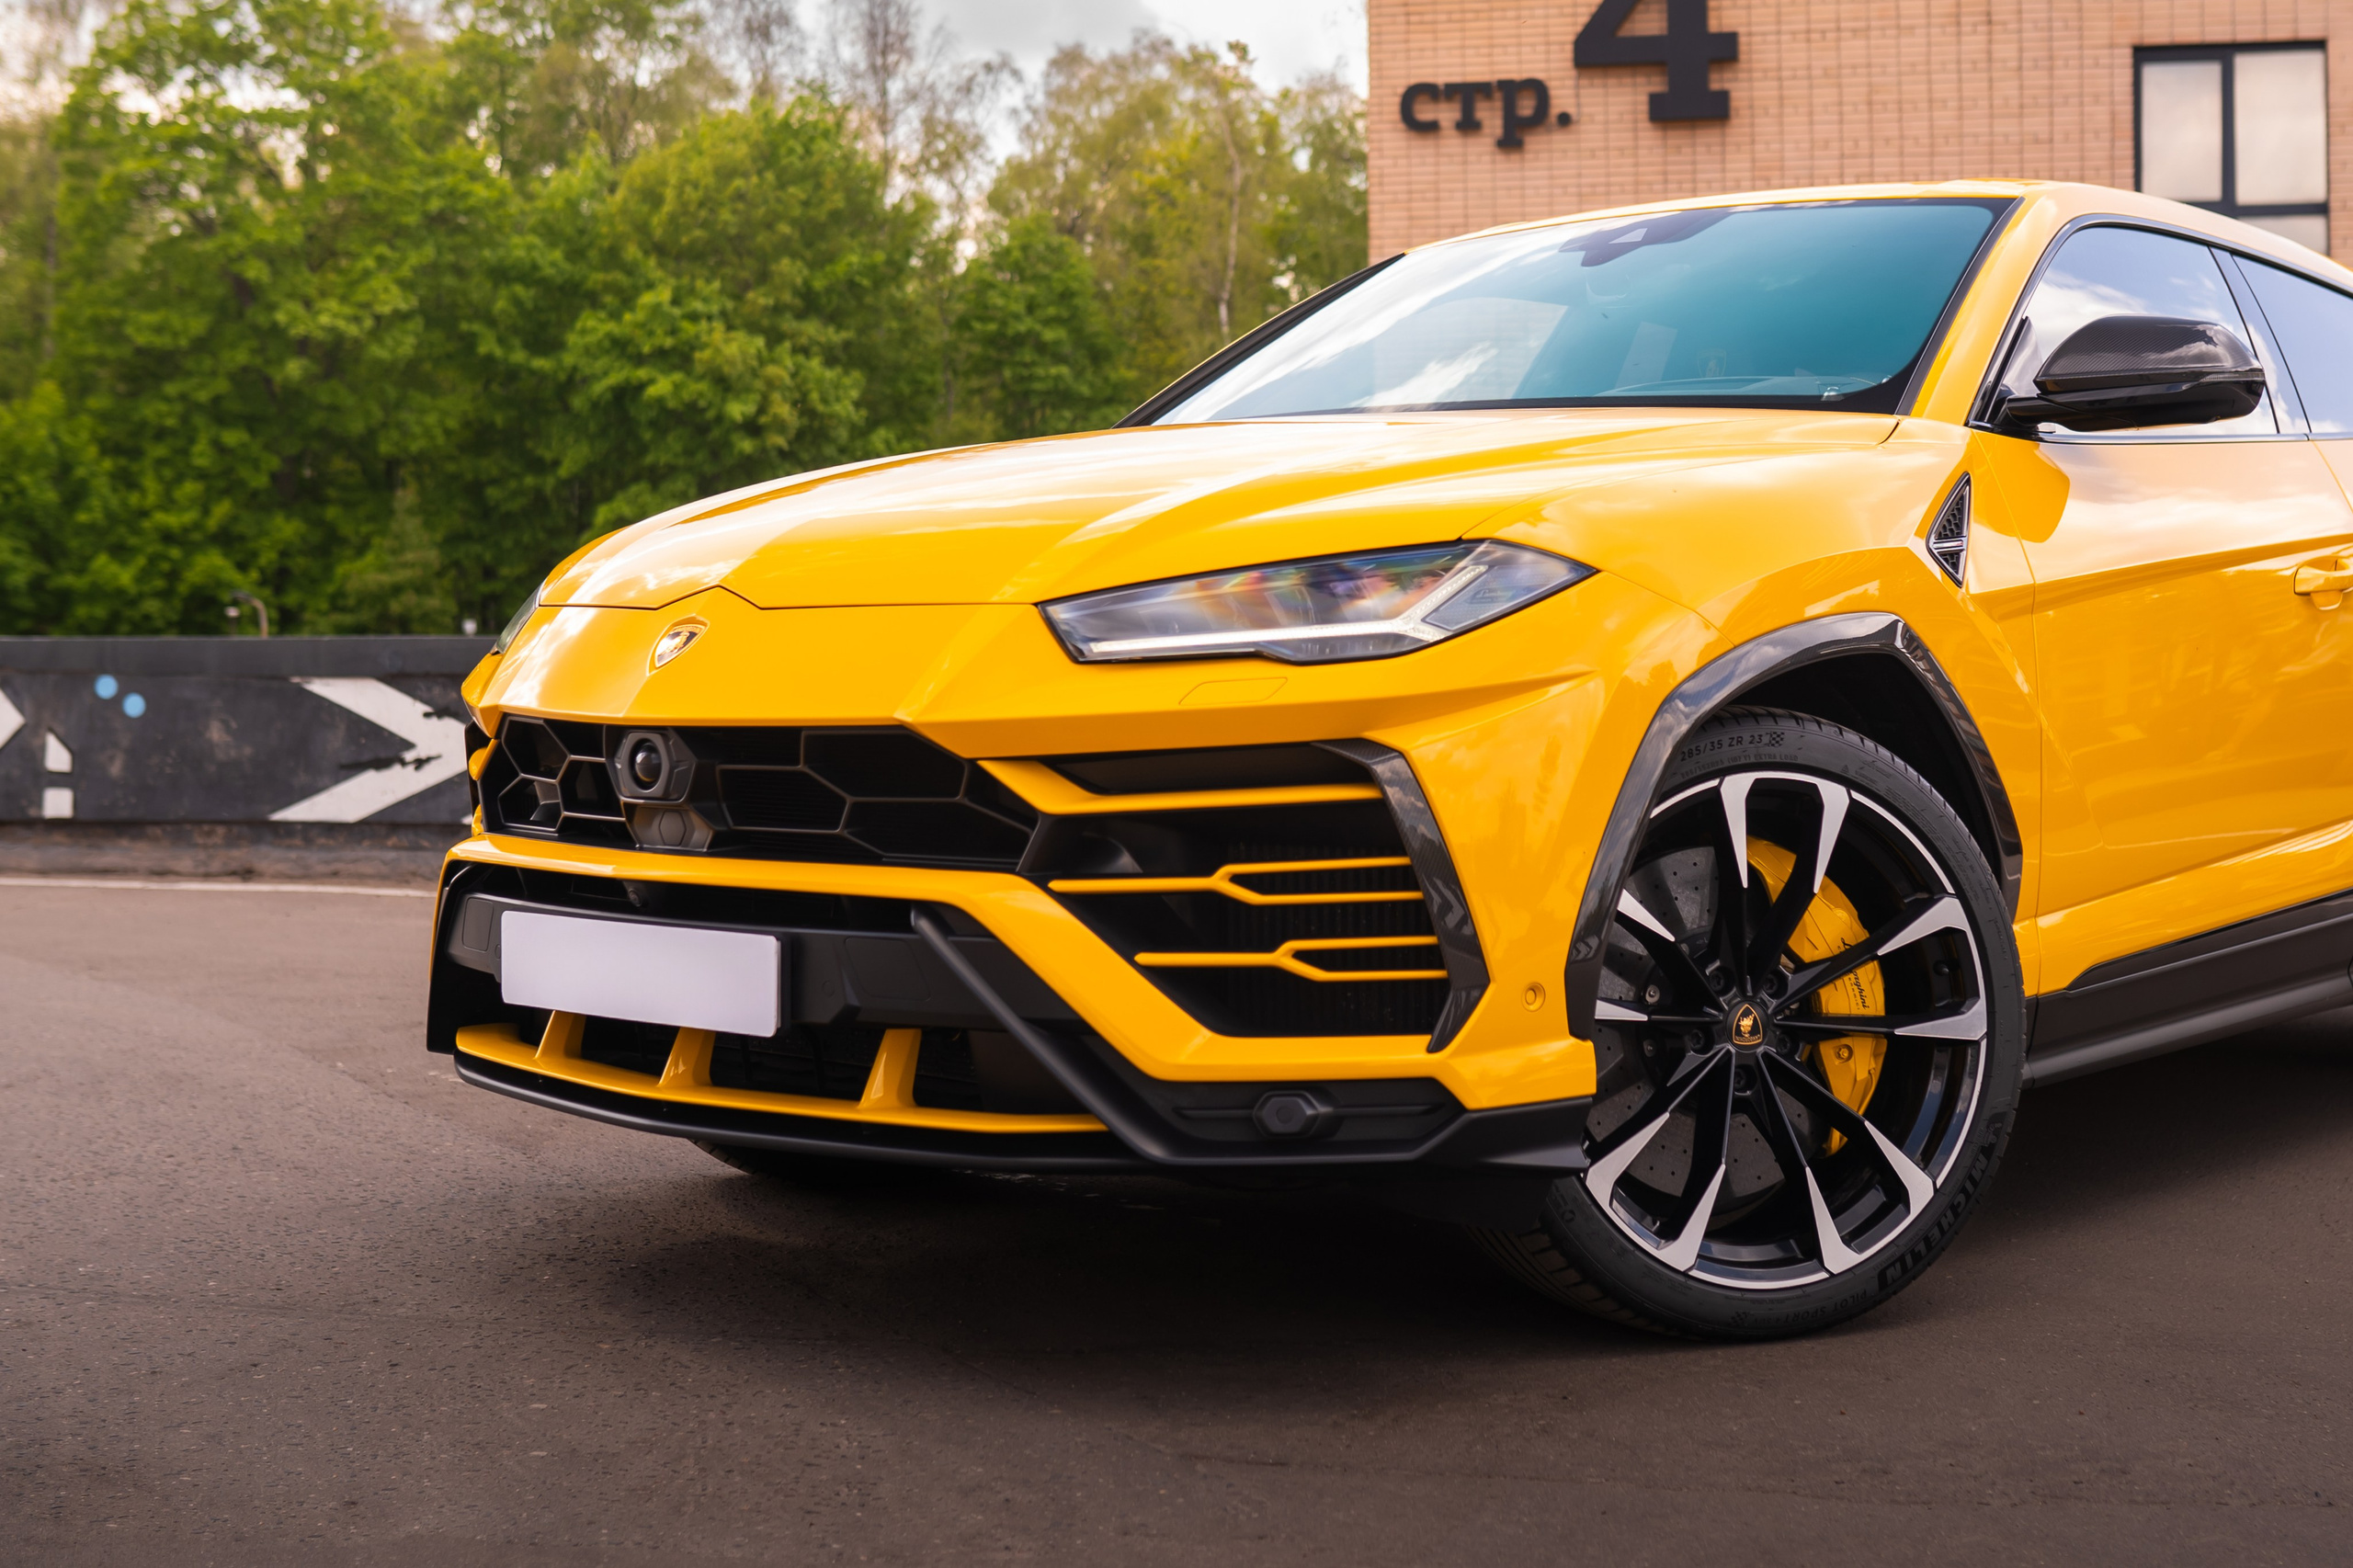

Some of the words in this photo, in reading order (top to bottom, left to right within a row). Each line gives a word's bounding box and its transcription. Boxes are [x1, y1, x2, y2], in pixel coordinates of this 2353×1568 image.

[1400, 77, 1573, 148] стр.
[1574, 0, 1739, 122] 4
[1680, 739, 1723, 762] 285/35
[1728, 735, 1744, 747] ZR
[1748, 733, 1763, 745] 23
[1886, 1153, 1989, 1285] MICHELIN
[1782, 1305, 1827, 1324] SPORT
[1832, 1289, 1868, 1312] PILOT
